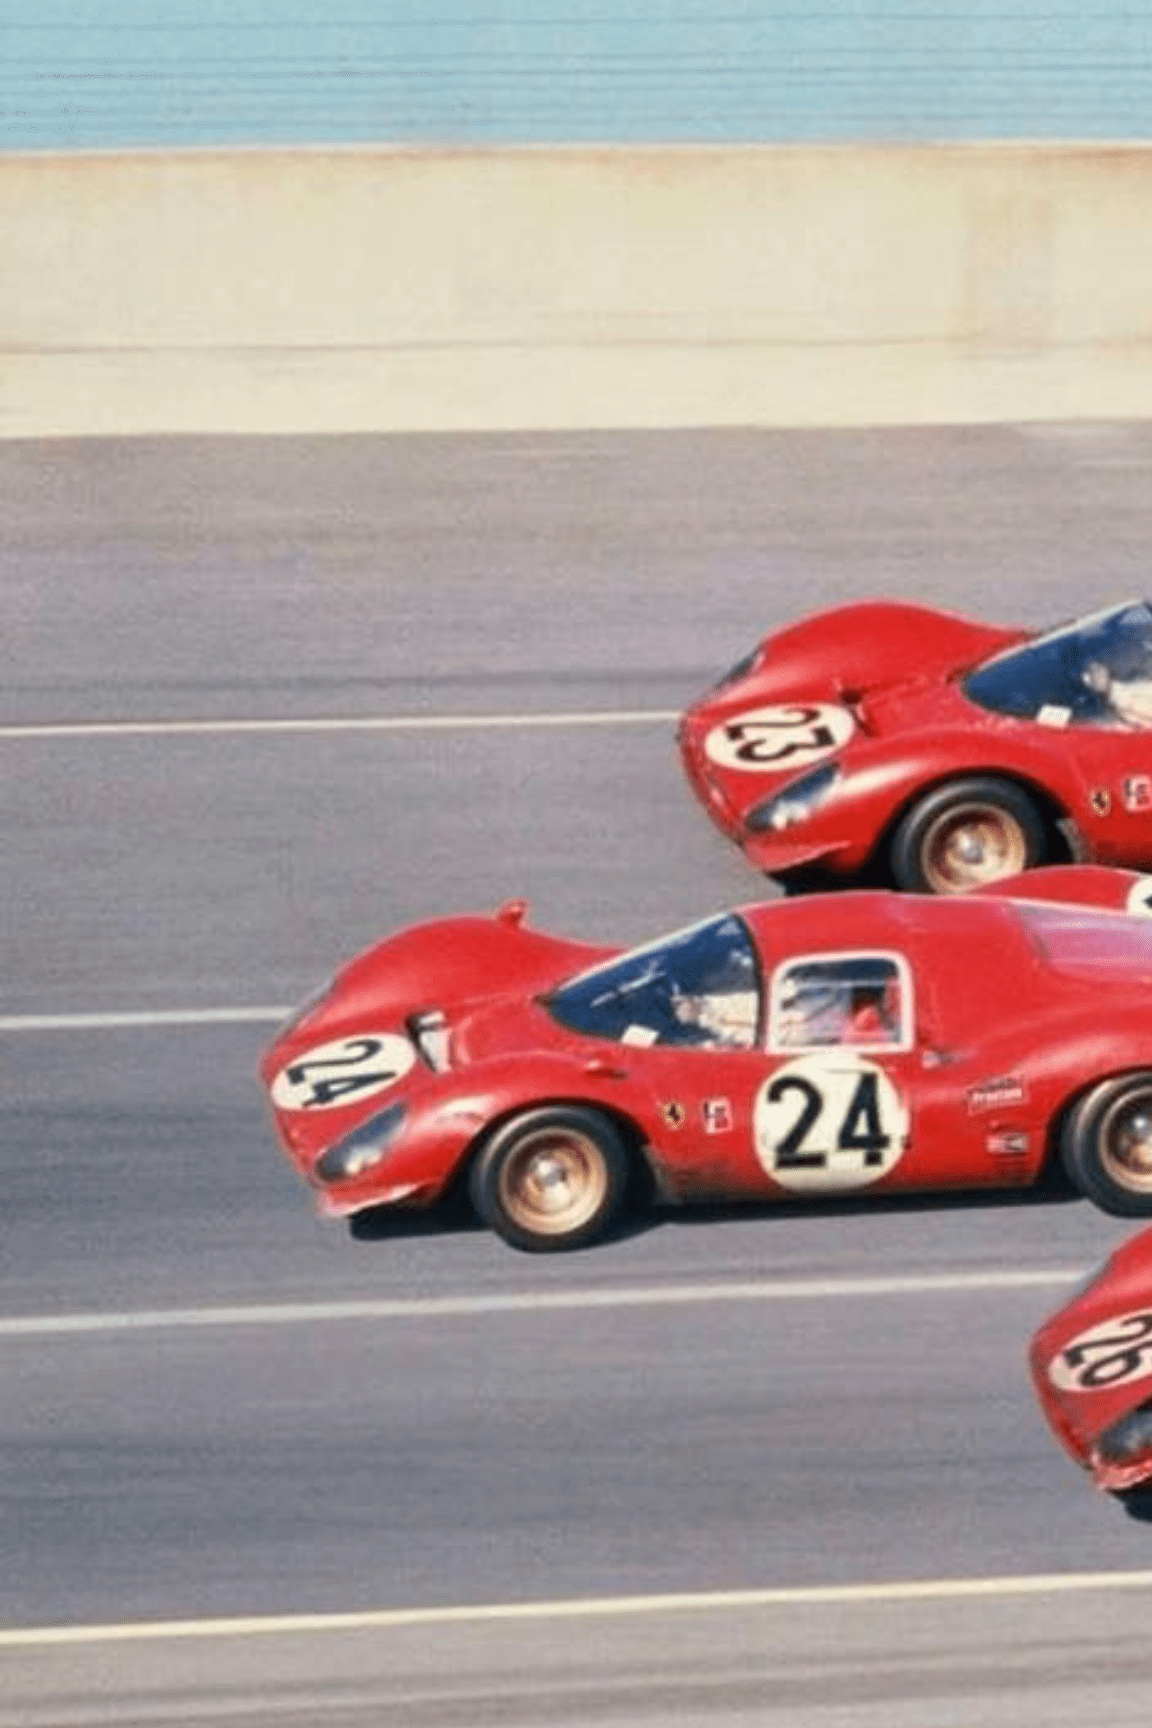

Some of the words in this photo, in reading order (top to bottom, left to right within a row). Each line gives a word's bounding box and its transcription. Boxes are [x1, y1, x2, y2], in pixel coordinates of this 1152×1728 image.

[725, 707, 835, 763] 23
[286, 1039, 396, 1108] 24
[767, 1073, 891, 1170] 24
